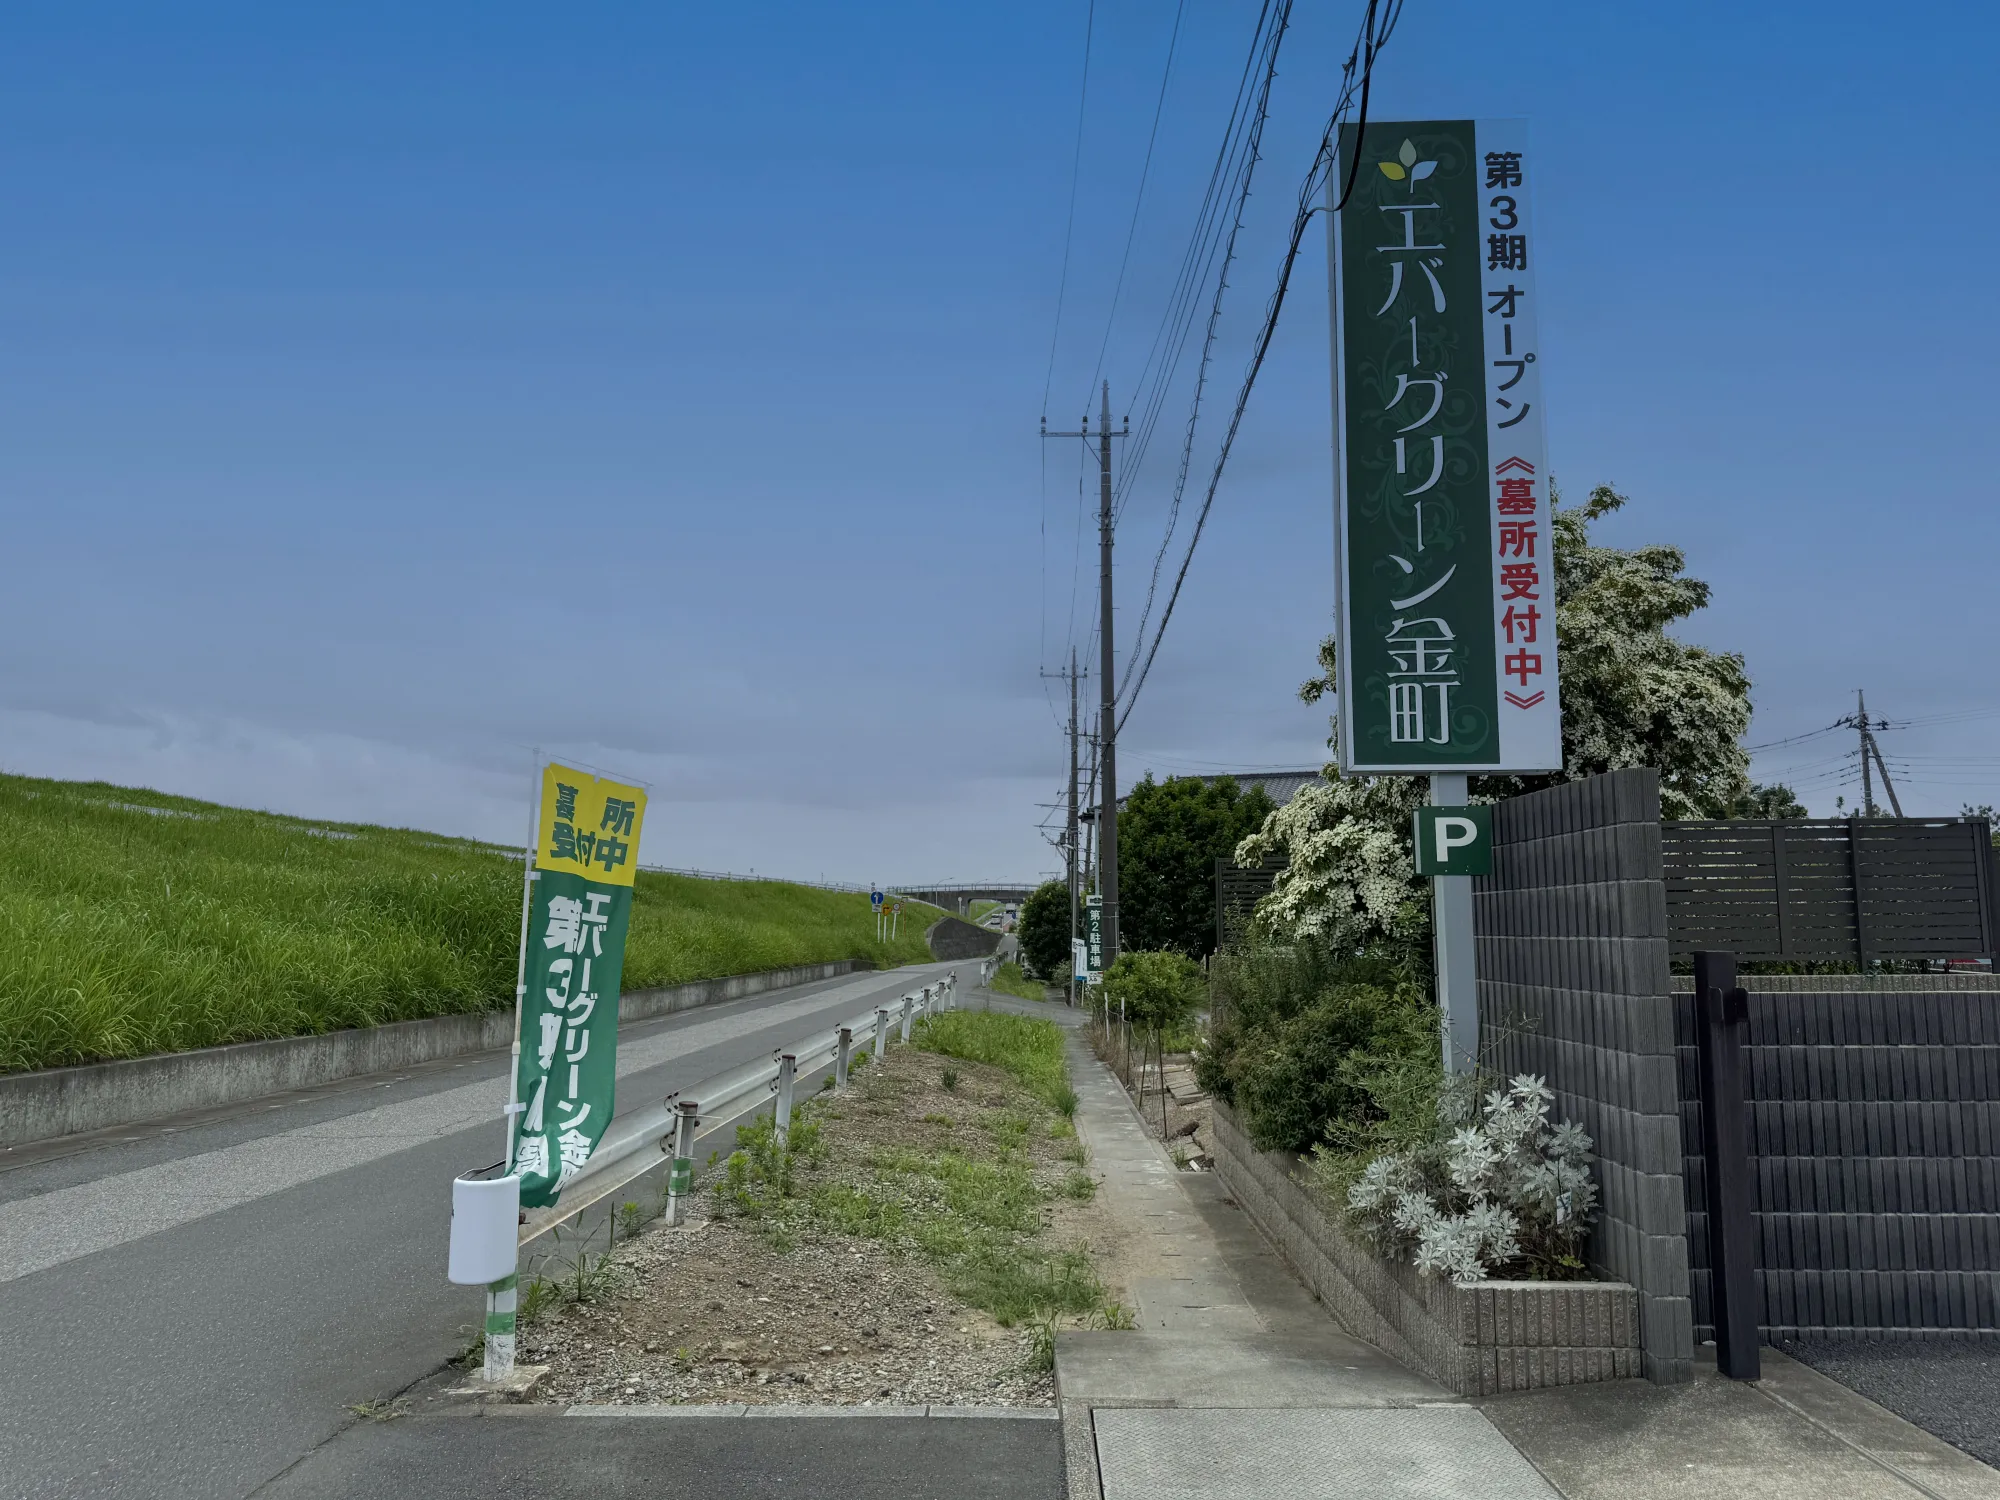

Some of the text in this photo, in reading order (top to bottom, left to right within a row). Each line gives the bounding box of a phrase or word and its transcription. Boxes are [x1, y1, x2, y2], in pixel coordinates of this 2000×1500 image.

[1484, 151, 1537, 429] 第3期 オープン
[1375, 201, 1462, 746] エバーグリーン金町
[1434, 816, 1478, 863] P
[1089, 909, 1102, 967] 第2駐車場
